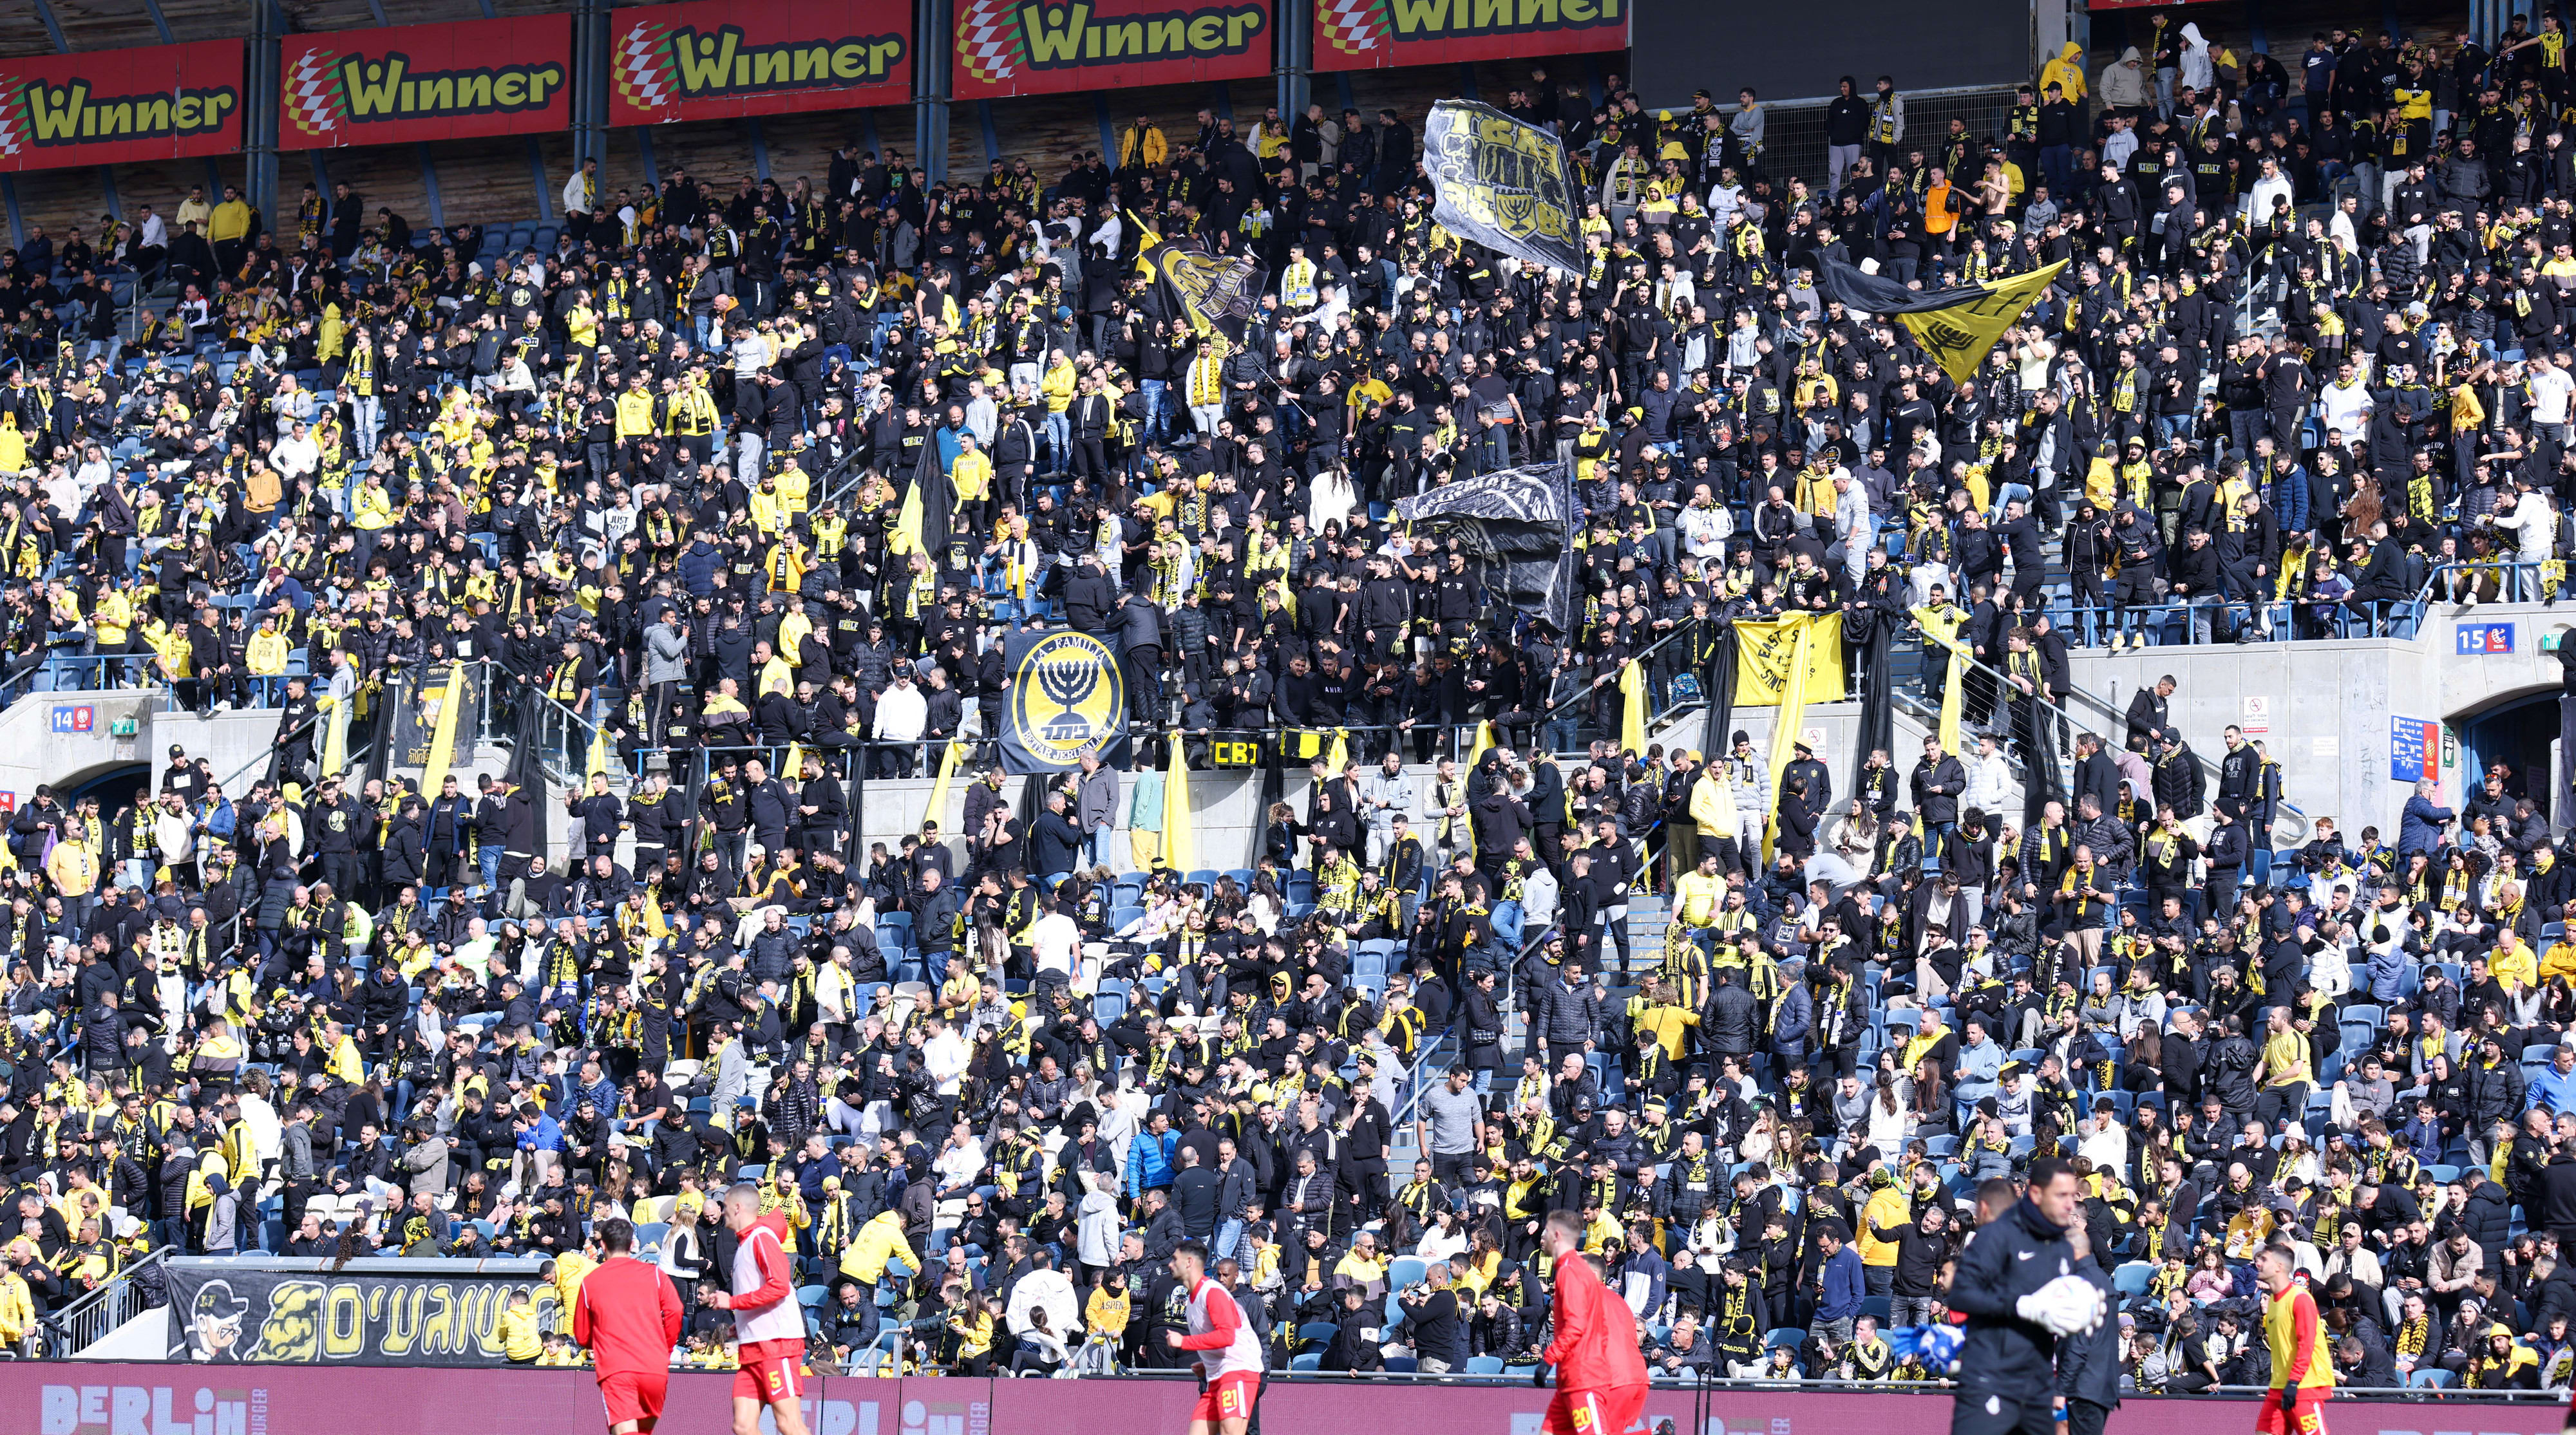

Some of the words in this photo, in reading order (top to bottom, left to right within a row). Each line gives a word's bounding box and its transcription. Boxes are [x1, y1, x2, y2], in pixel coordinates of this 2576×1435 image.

[1023, 3, 1259, 62] Winner
[676, 32, 900, 91] Winner
[344, 59, 560, 115] Winner
[30, 86, 232, 140] Winner
[611, 515, 629, 524] JUST
[1030, 650, 1045, 664] LA
[1054, 636, 1106, 662] FAMILIA
[1758, 630, 1783, 659] EAST
[2459, 630, 2485, 649] 15
[1760, 669, 1787, 693] SINC
[54, 711, 73, 727] 14
[1040, 725, 1090, 740] ביתר
[768, 1370, 782, 1389] 5
[1222, 1389, 1238, 1407] 21
[1572, 1406, 1591, 1428] 20
[2300, 1413, 2318, 1432] 55
